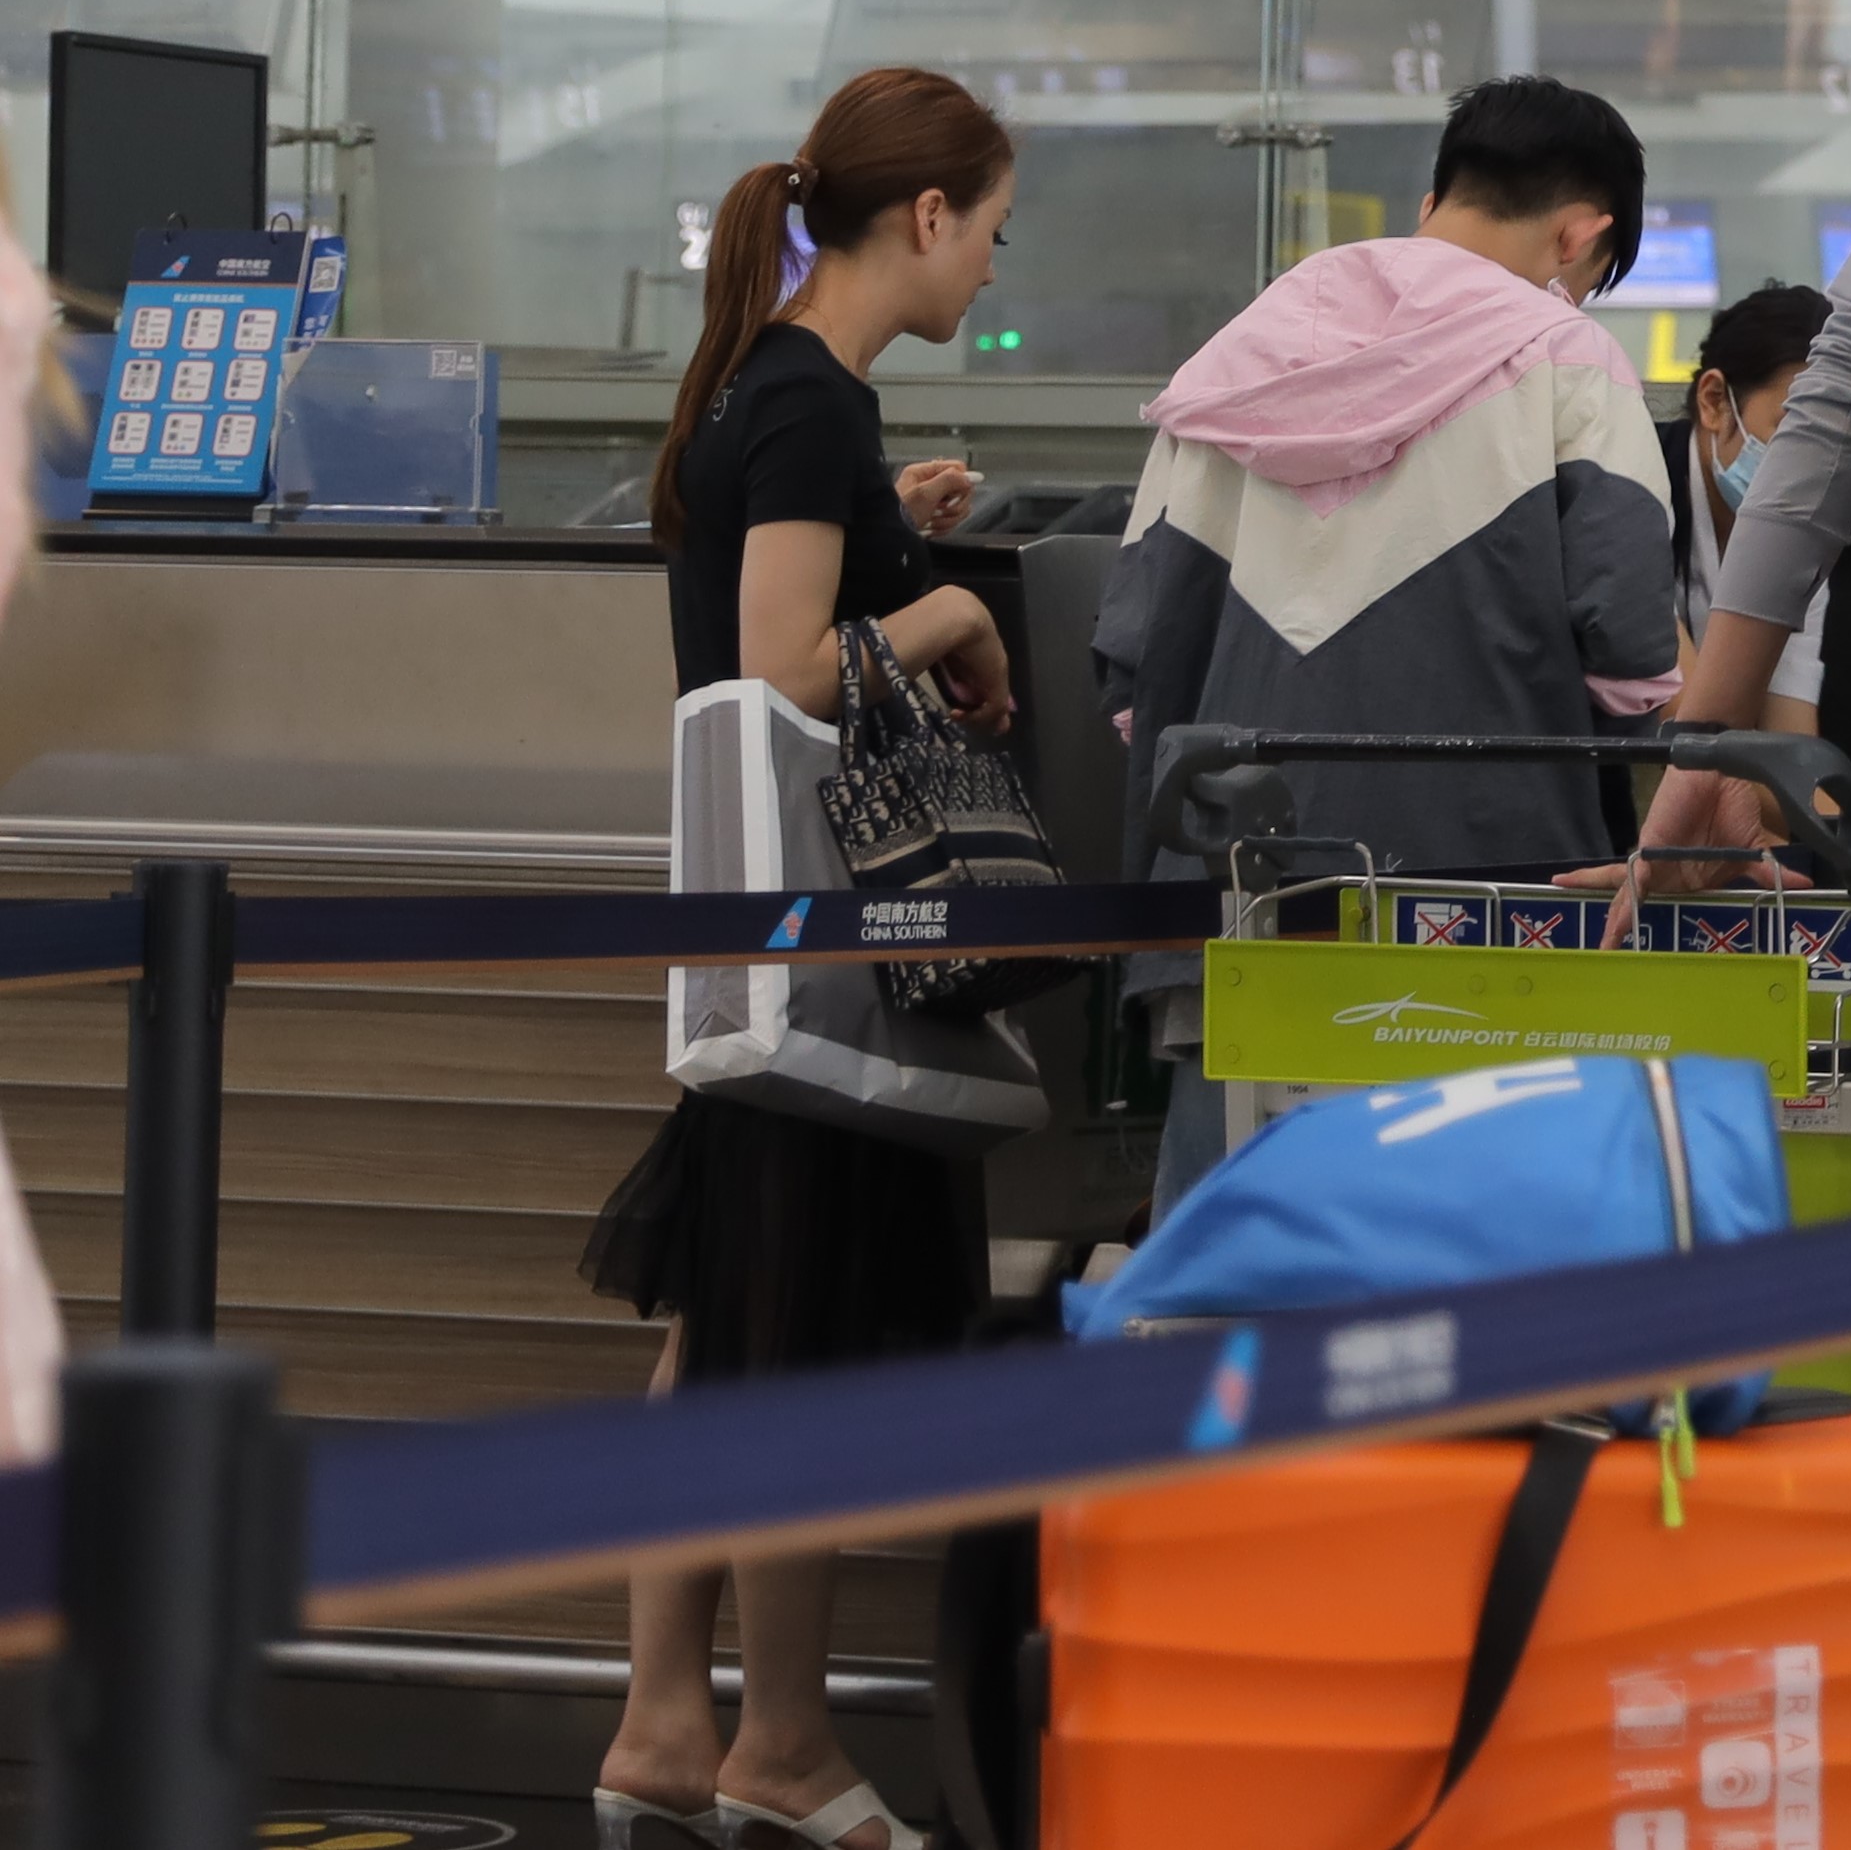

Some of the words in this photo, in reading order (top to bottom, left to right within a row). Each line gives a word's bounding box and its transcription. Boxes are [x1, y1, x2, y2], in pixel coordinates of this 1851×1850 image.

[862, 900, 948, 927] 中国南方航空
[861, 924, 893, 941] CHINA
[895, 923, 947, 940] SOUTHERN
[1374, 1026, 1519, 1047] BAIYUNPORT
